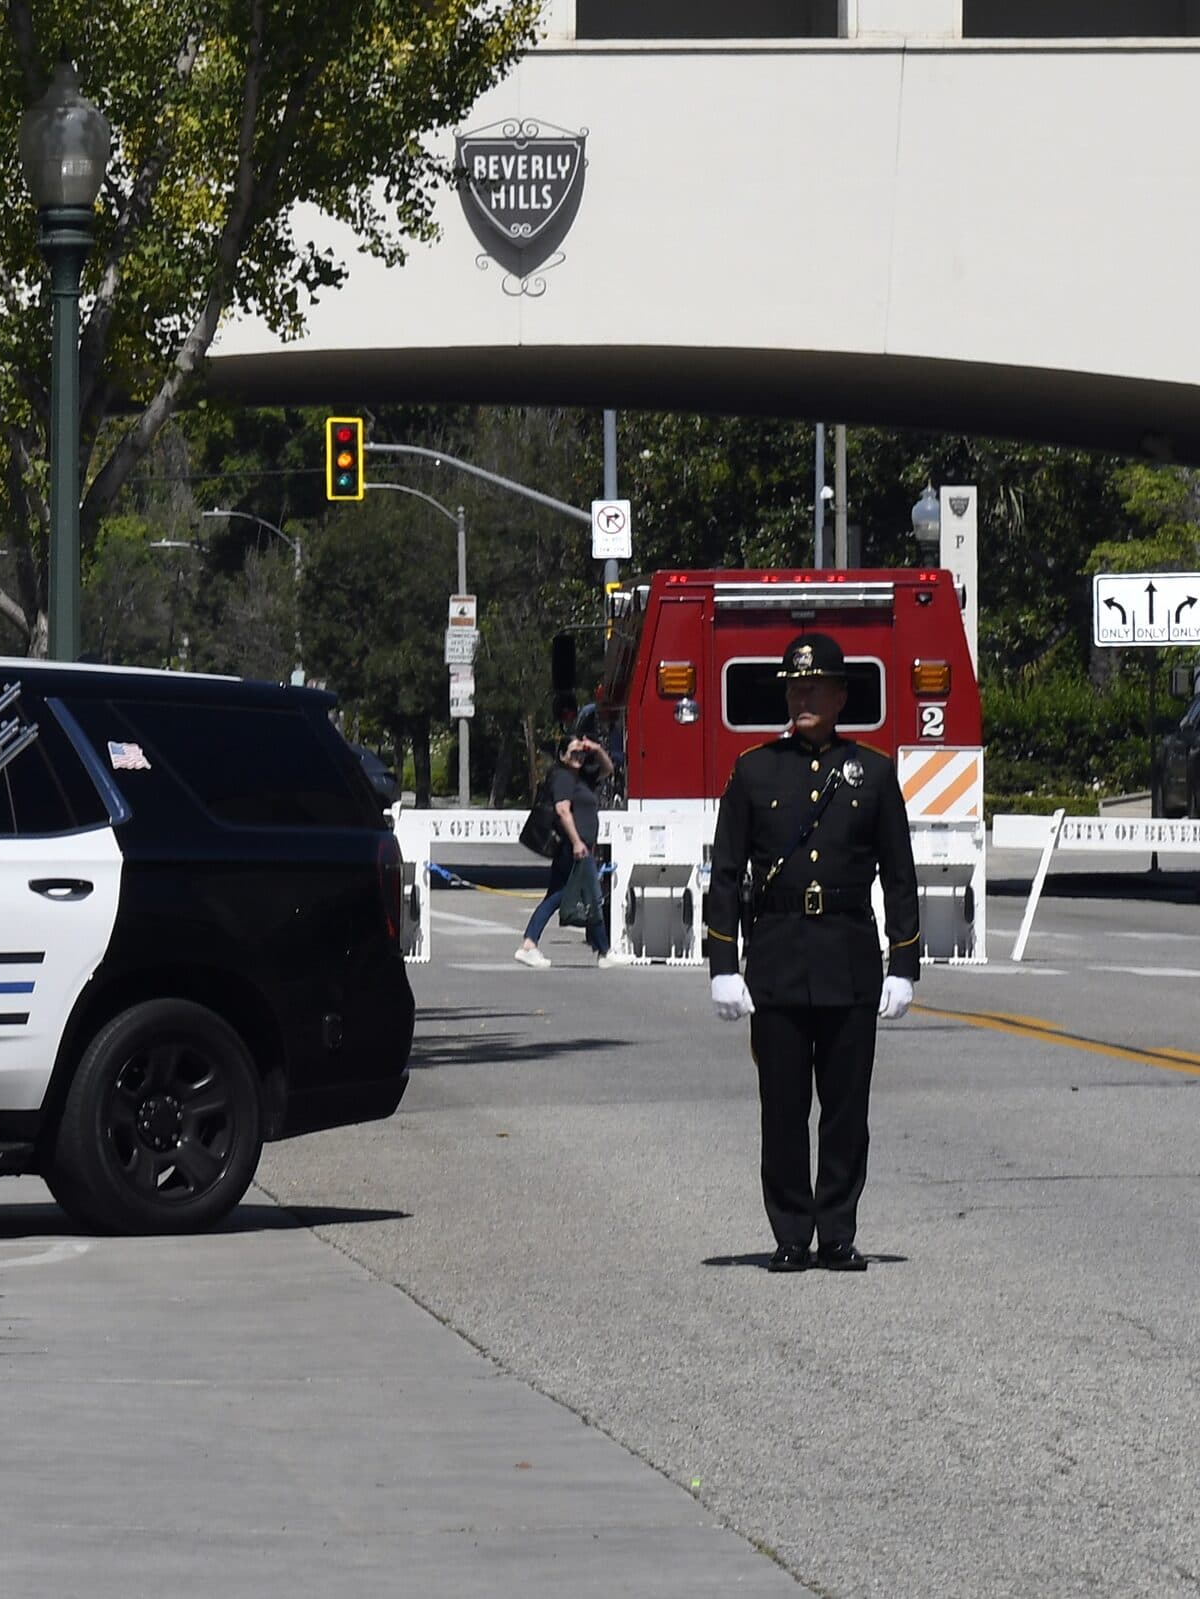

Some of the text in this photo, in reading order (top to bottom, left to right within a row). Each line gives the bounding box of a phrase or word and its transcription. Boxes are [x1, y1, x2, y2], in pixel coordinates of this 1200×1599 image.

[473, 154, 571, 180] BEVERLY
[490, 184, 552, 210] HILLS
[1101, 628, 1130, 639] ONLY
[1136, 627, 1166, 639] ONLY
[921, 706, 945, 737] 2
[449, 820, 475, 837] OF
[1063, 823, 1109, 840] CITY
[1115, 824, 1139, 841] OF
